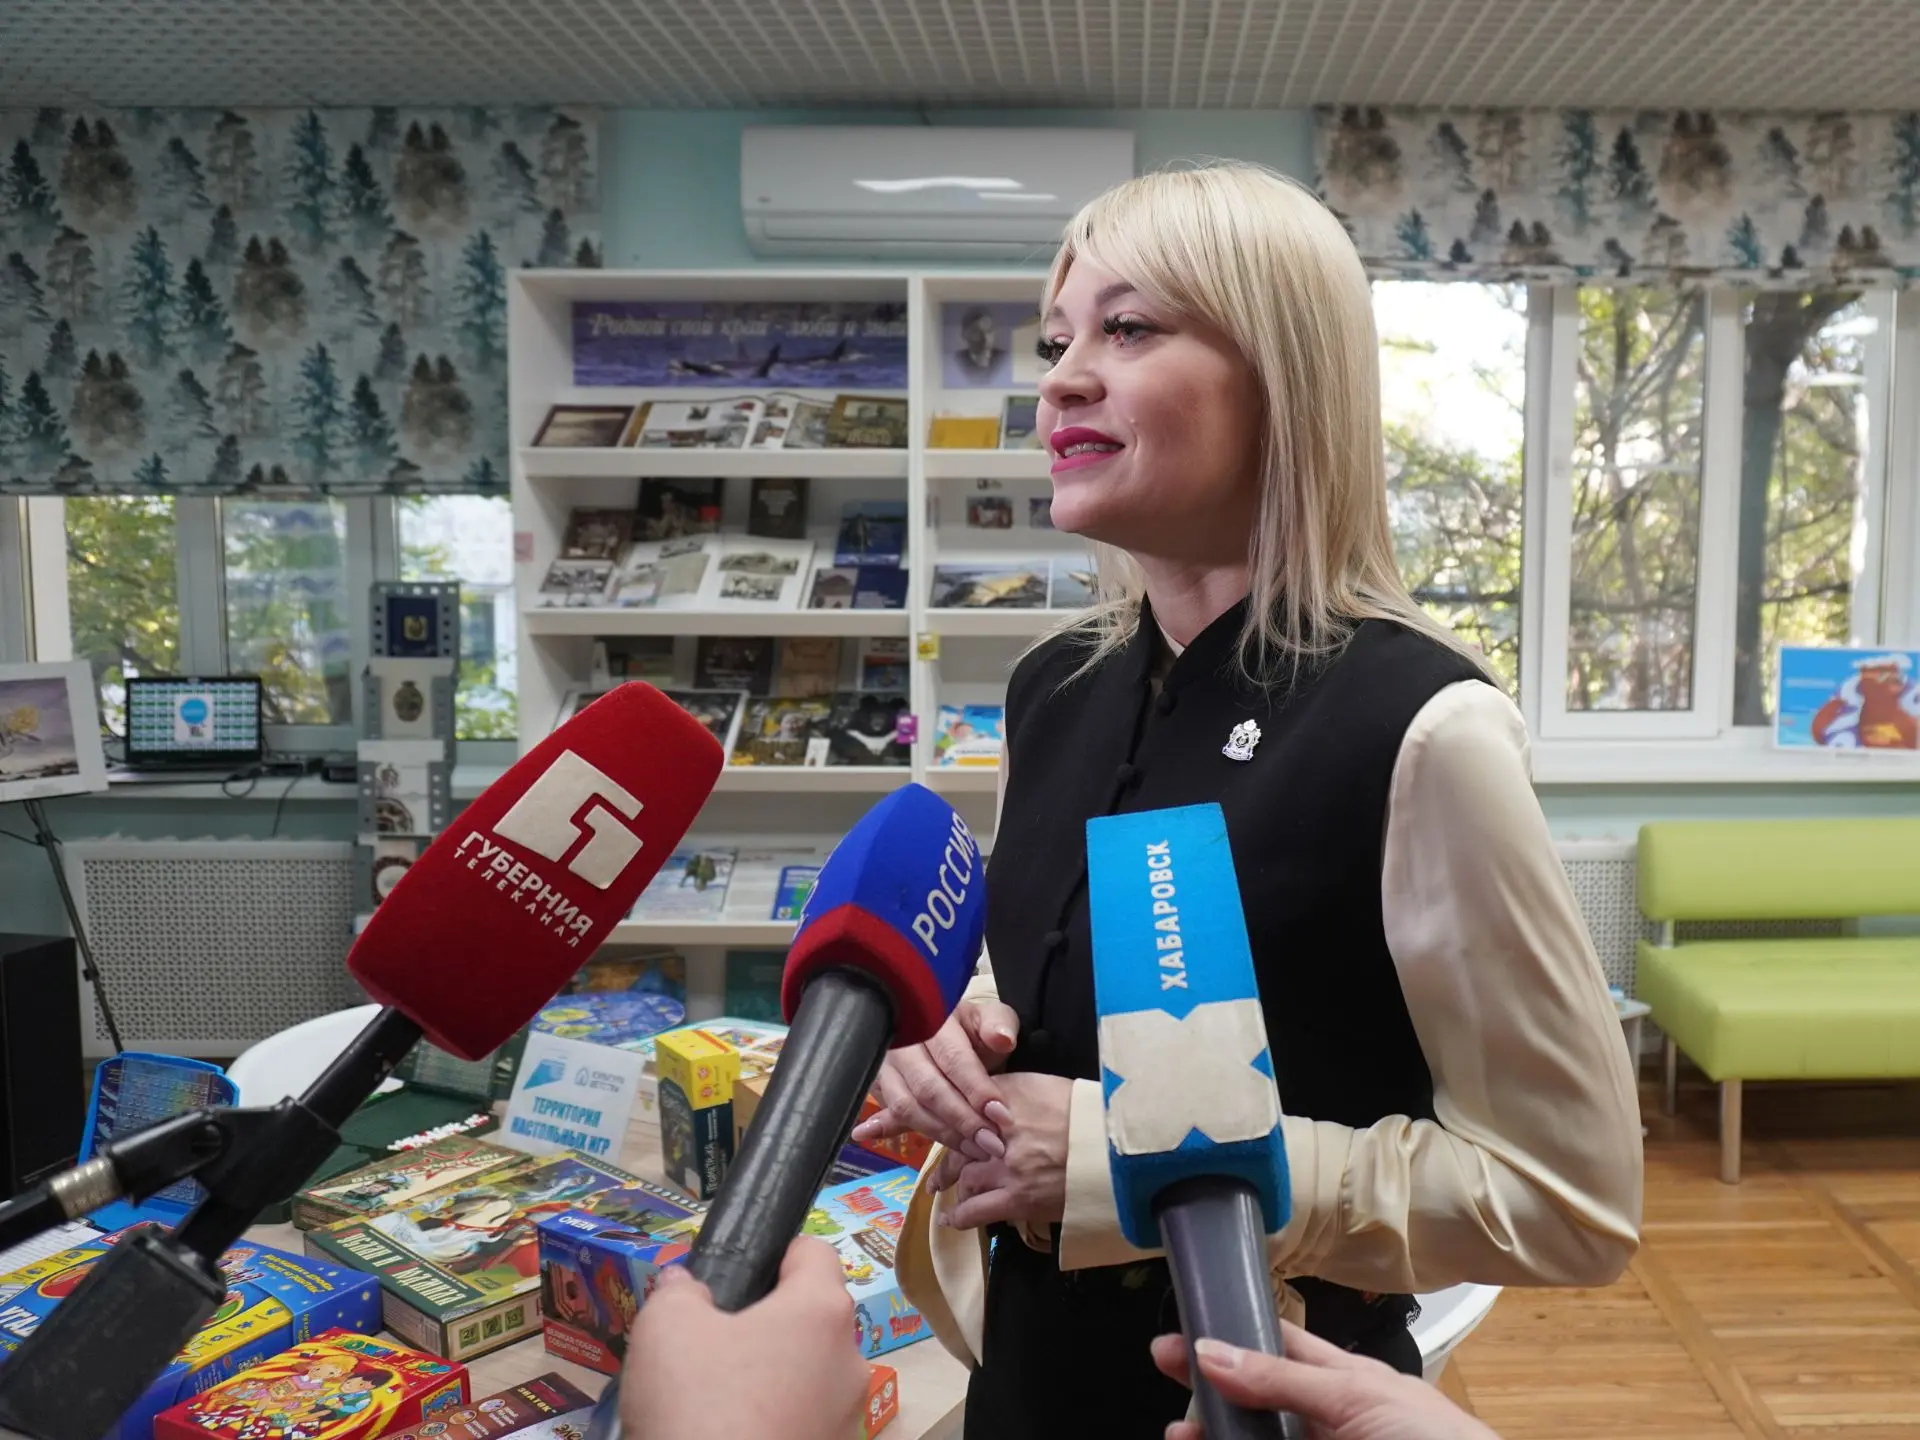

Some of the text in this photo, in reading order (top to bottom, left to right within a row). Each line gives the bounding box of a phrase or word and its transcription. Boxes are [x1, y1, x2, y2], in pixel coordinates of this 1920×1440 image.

[453, 847, 580, 948] ТЕЛЕКАНАЛ
[460, 831, 594, 937] ГУБЕРНИЯ
[912, 811, 980, 956] РОССИЯ
[1147, 839, 1189, 991] ХАБАРОВСК
[511, 1117, 611, 1156] НАСТОЛЬНЫХ ИГР
[533, 1096, 602, 1128] ТЕРРИТОРИЯ
[517, 1387, 550, 1412] ЗНАТОК
